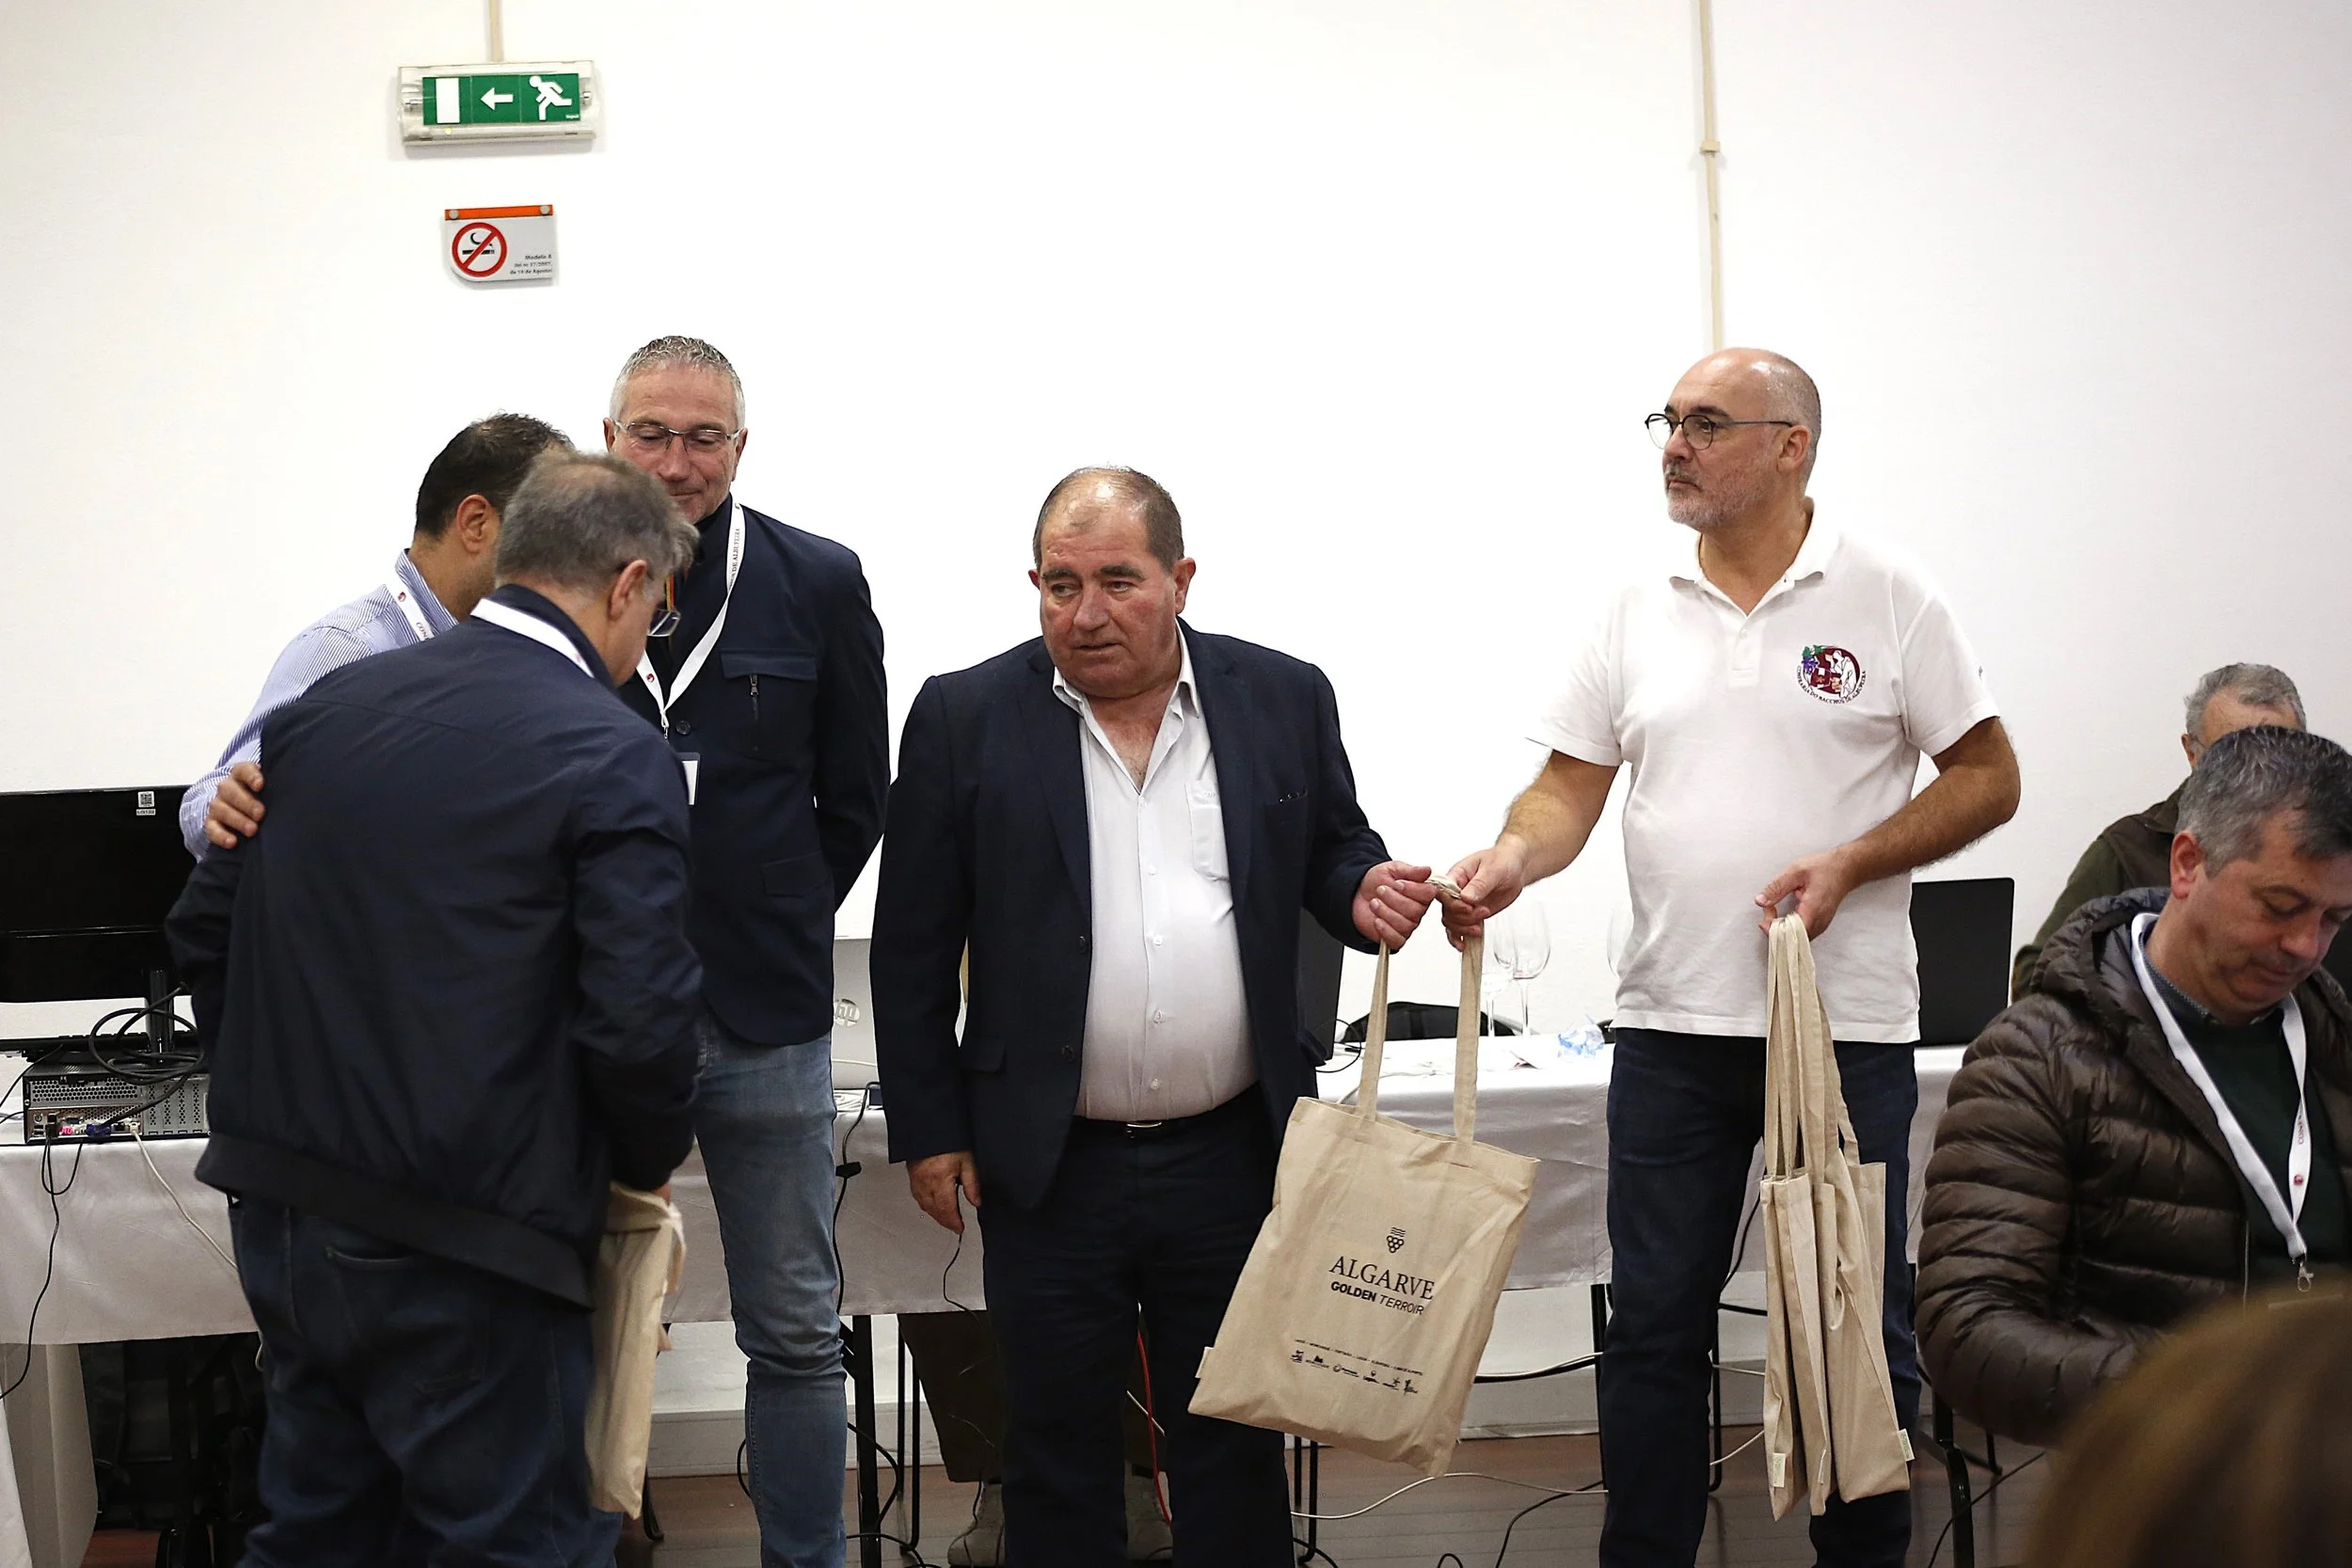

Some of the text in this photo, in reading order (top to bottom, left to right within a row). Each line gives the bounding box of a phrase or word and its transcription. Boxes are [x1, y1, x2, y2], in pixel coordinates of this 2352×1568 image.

[1328, 1256, 1435, 1300] ALGARVE
[1330, 1280, 1425, 1316] GOLDEN TERROIR
